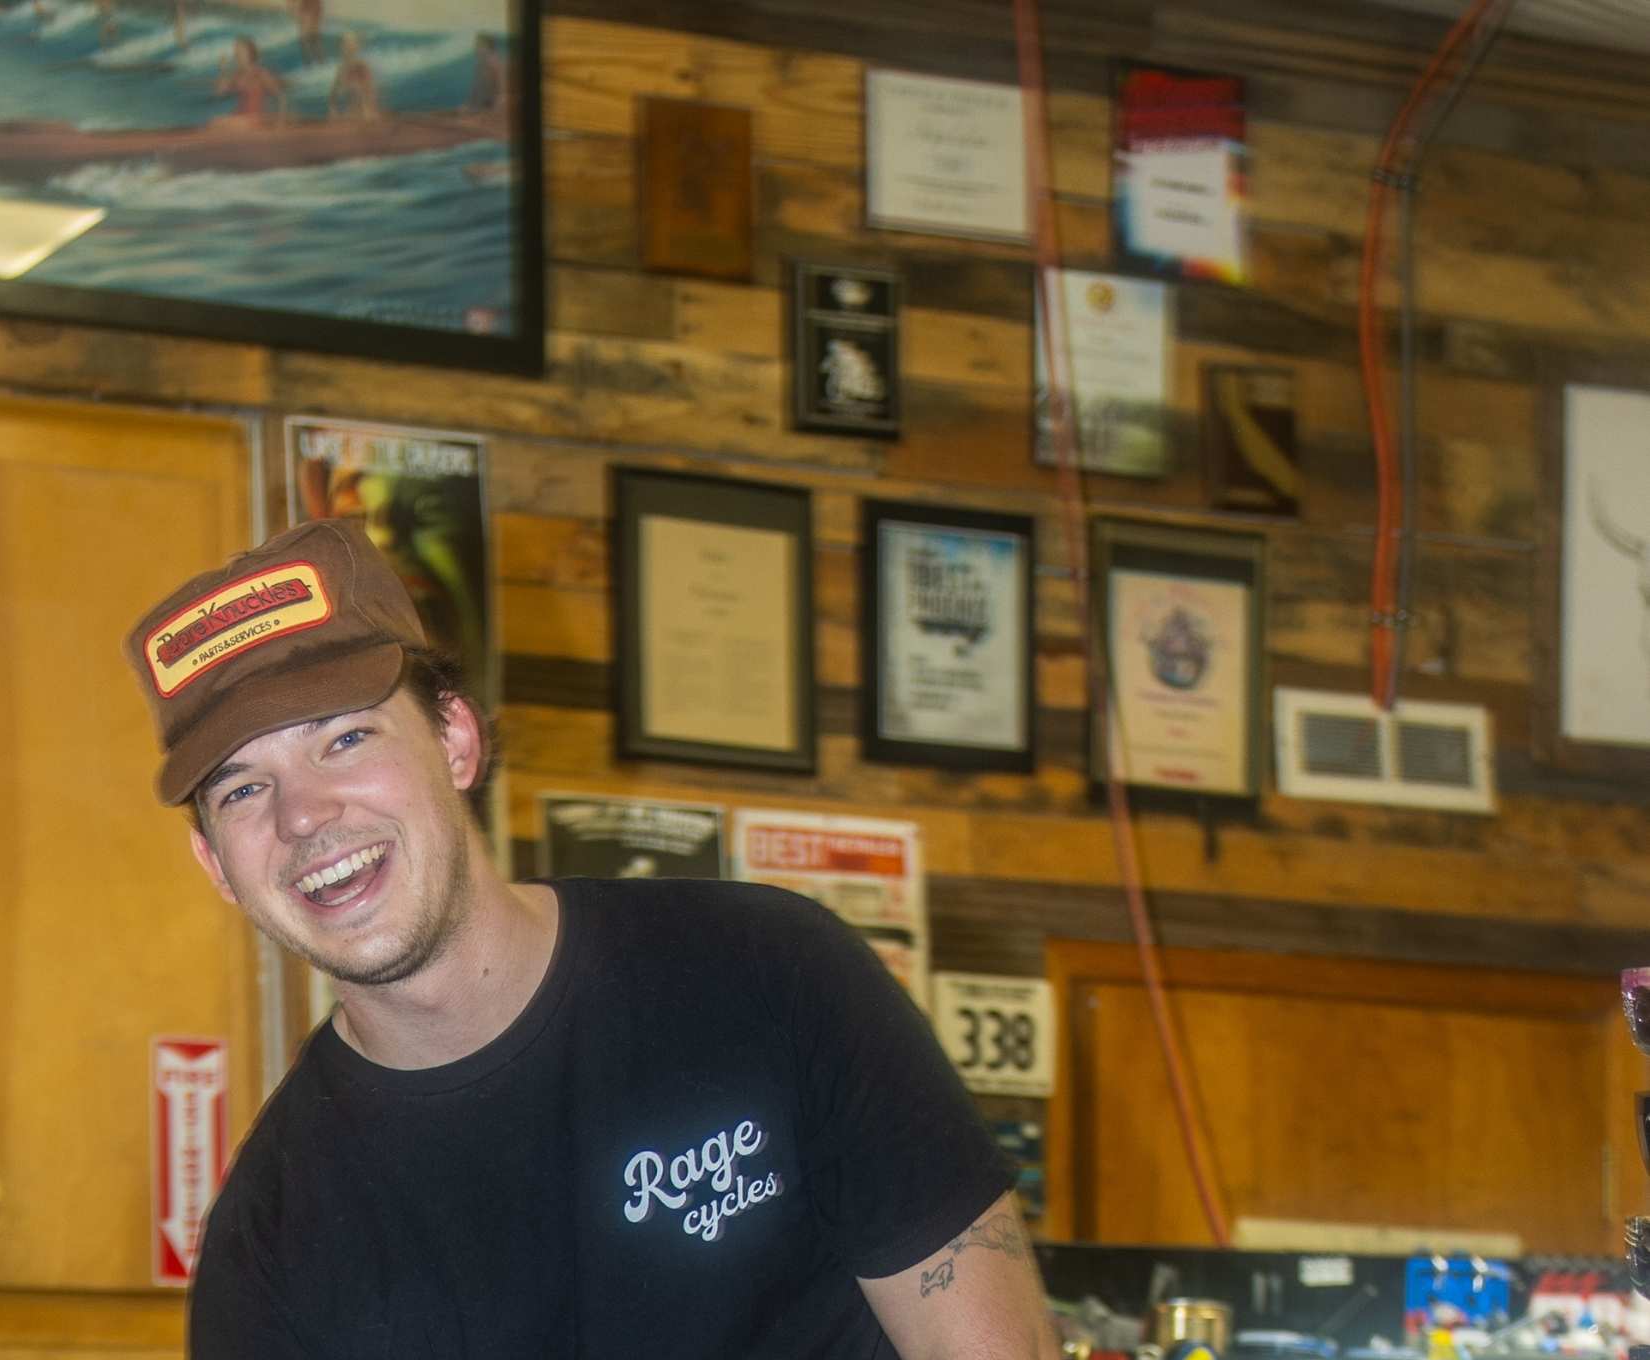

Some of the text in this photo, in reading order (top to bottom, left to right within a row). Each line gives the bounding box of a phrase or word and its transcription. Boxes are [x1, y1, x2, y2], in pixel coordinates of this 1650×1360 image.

[750, 825, 827, 868] BEST
[957, 1008, 1035, 1071] 338
[623, 1120, 763, 1223] Rage
[682, 1171, 778, 1242] cycles
